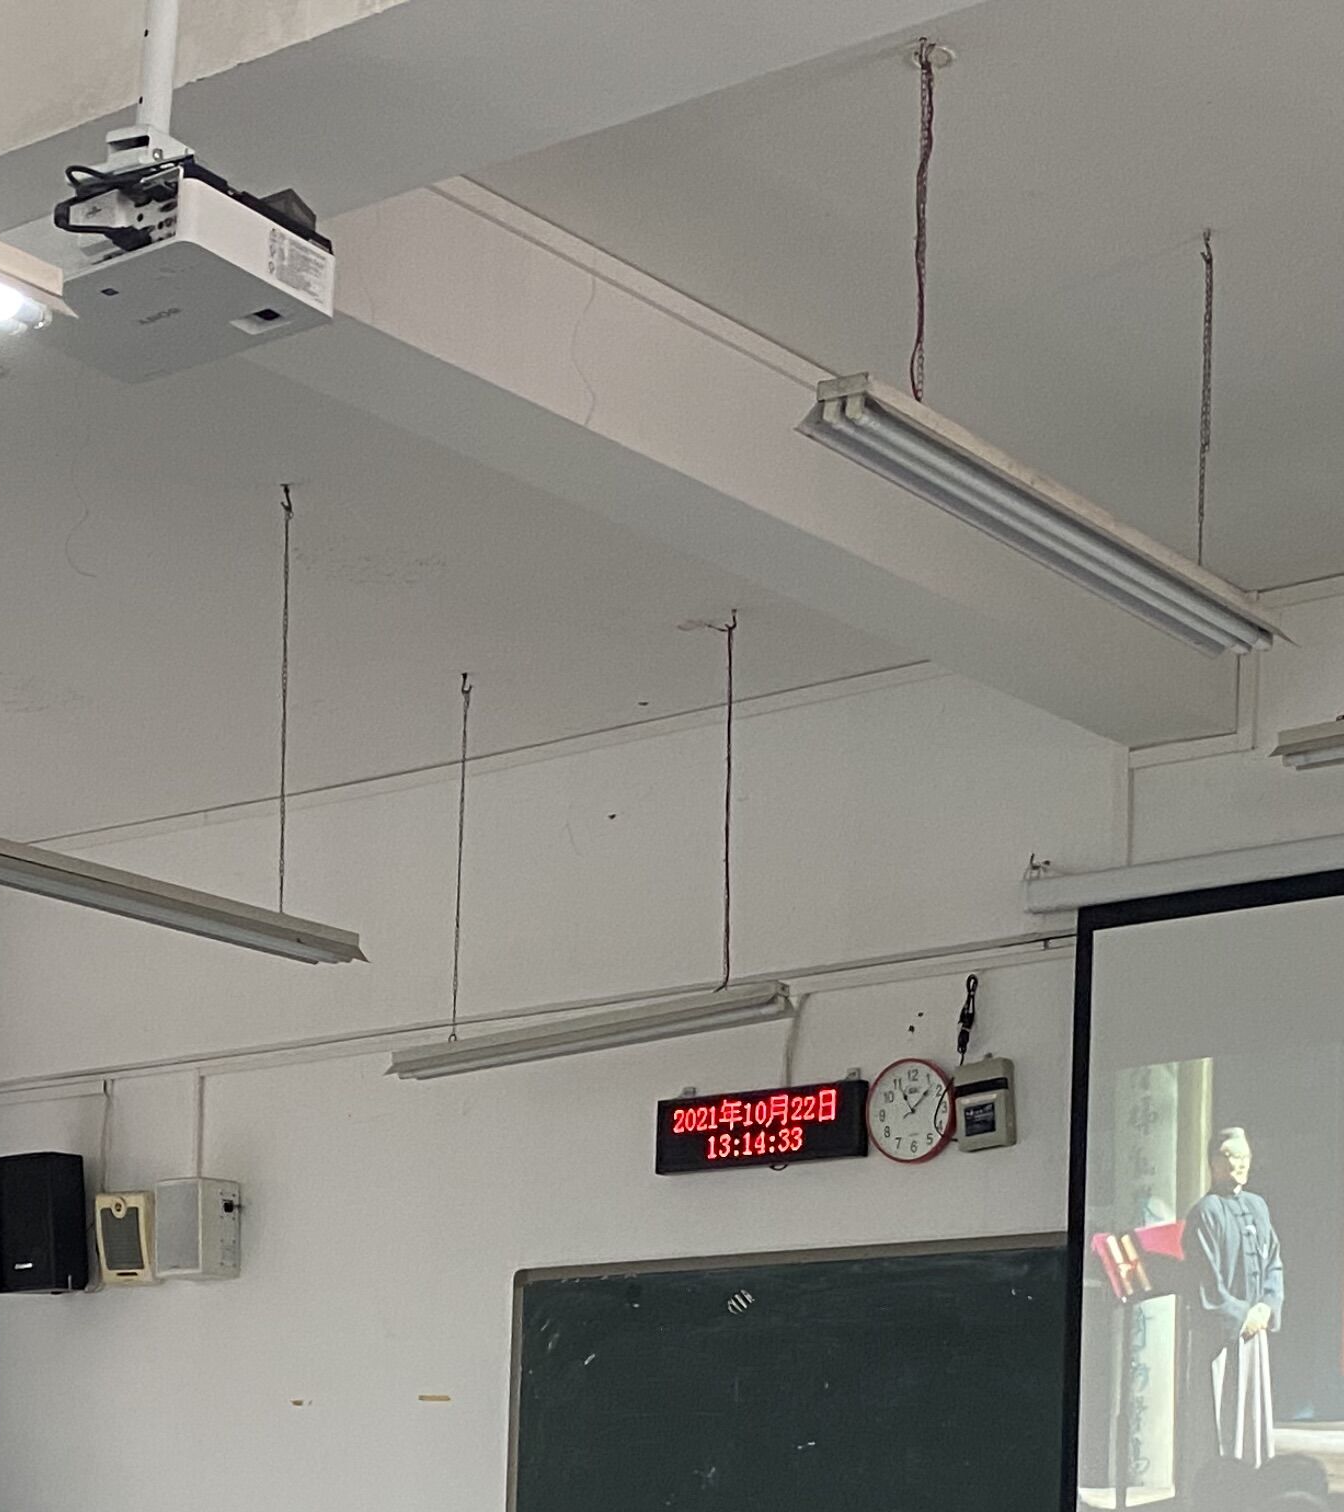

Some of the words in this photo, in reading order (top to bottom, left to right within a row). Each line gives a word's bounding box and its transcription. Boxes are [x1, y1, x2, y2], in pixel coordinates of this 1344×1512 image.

[907, 1068, 919, 1082] 12
[935, 1084, 942, 1097] 2
[673, 1088, 837, 1134] 2021年10月22日
[879, 1109, 886, 1122] 9
[883, 1125, 891, 1138] 8
[707, 1128, 804, 1160] 13:14:33
[894, 1137, 902, 1149] 7
[926, 1133, 933, 1145] 5
[910, 1140, 918, 1153] 6
